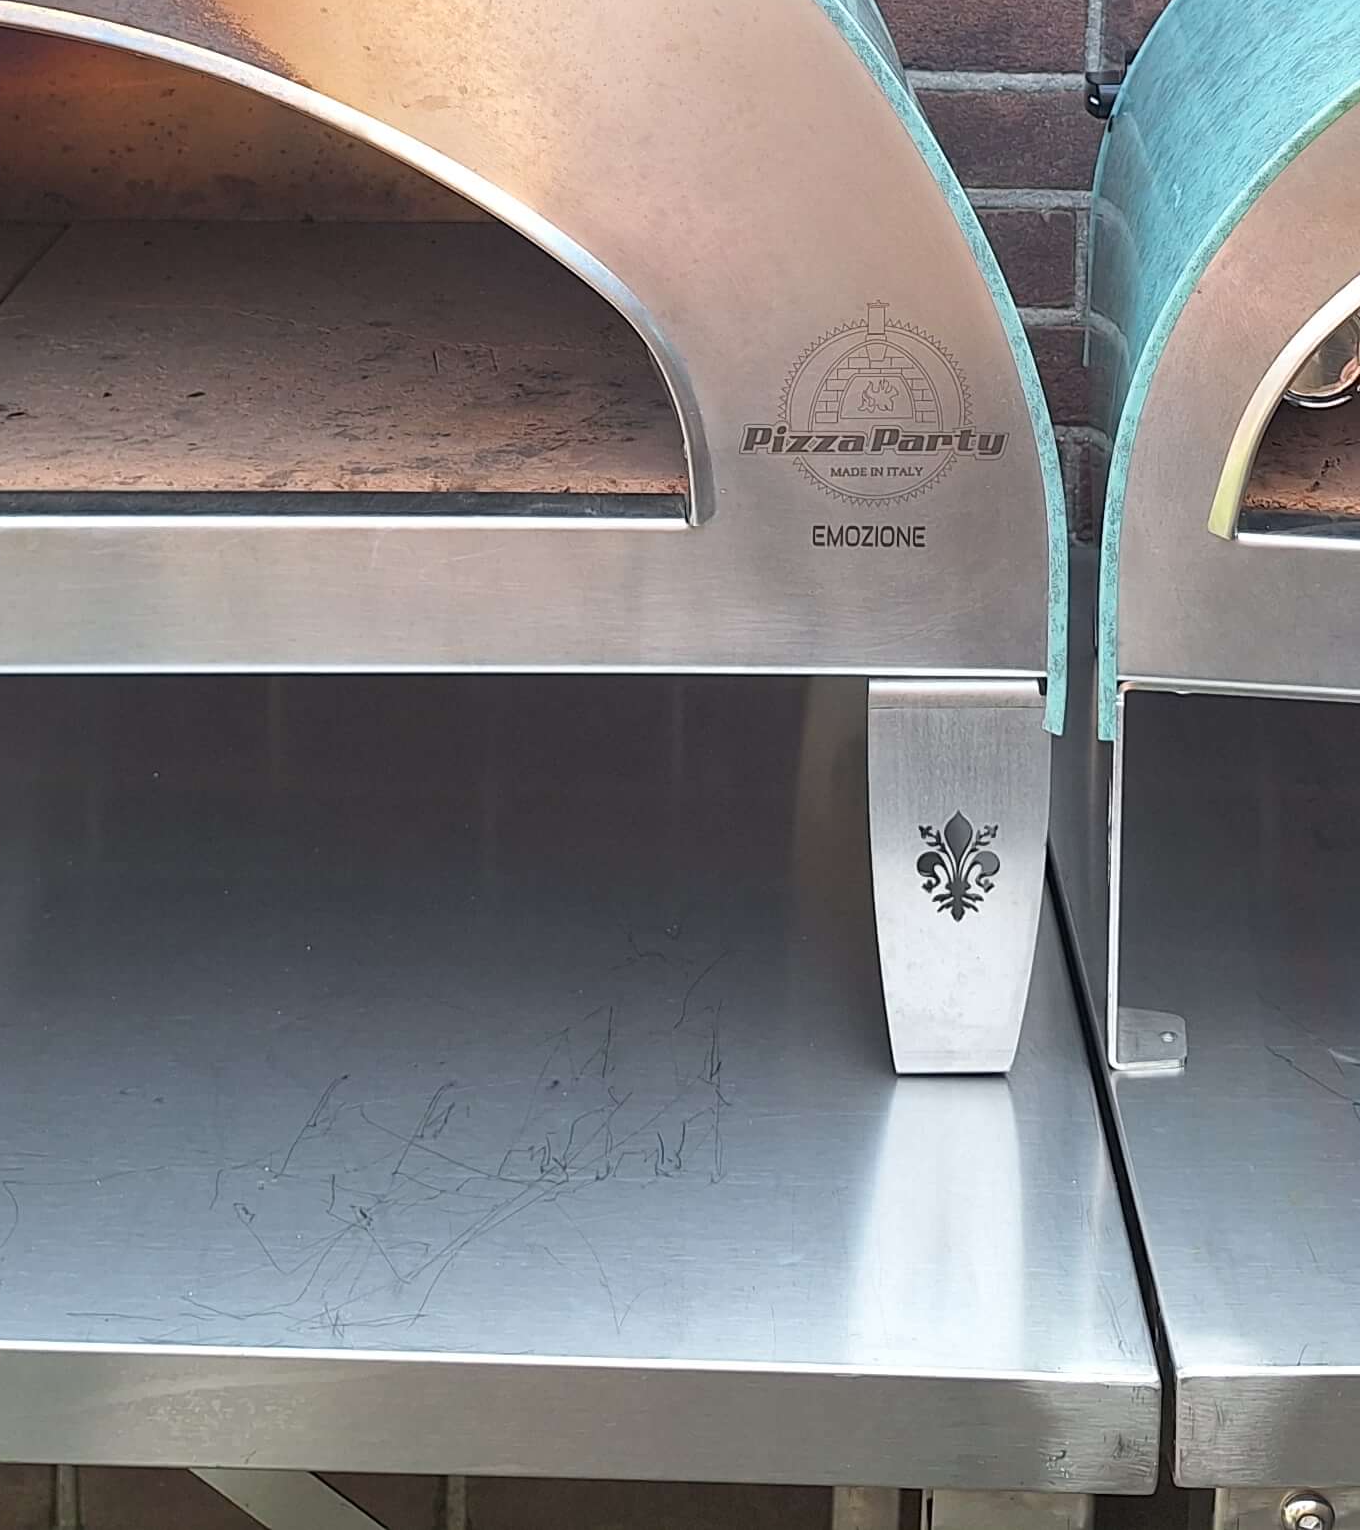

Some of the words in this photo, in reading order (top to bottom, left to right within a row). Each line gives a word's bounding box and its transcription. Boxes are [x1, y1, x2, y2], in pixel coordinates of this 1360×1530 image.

[830, 467, 868, 478] MADE
[870, 467, 884, 477] IN
[886, 466, 924, 478] ITALY
[812, 525, 926, 548] EMOZIONE
